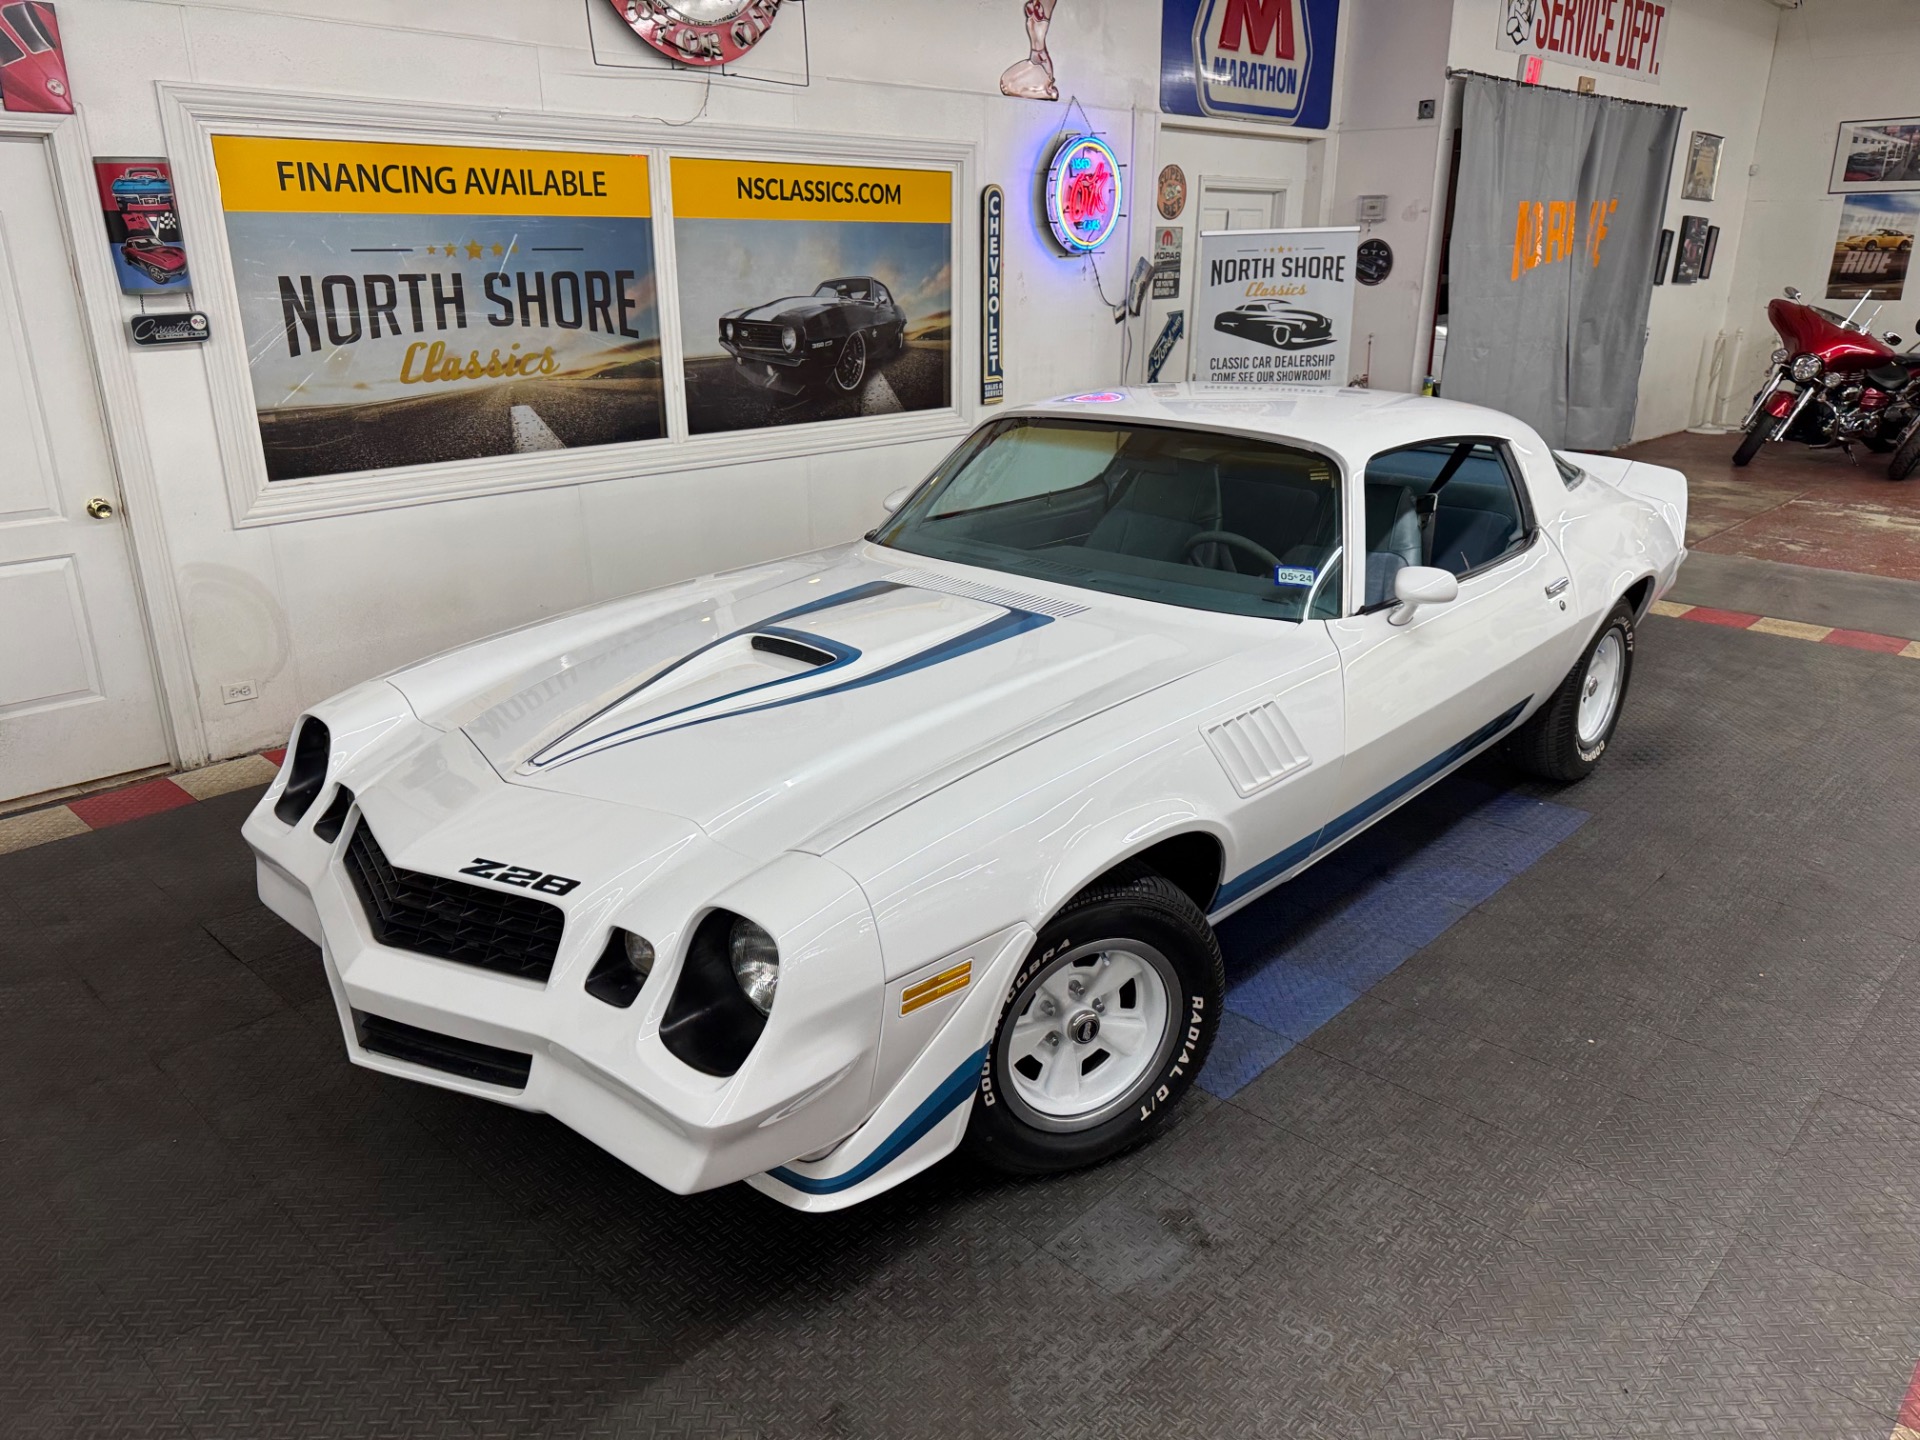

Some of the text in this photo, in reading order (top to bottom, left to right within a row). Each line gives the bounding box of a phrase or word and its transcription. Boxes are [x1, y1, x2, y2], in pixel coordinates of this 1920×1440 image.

[624, 0, 724, 62] OTOR
[1536, 0, 1665, 75] SERVICE DEPT.
[1212, 56, 1298, 95] MARATHON
[276, 161, 608, 197] FINANCING AVAILABLE
[737, 176, 902, 205] NSCLASSICS.COM
[1163, 197, 1182, 217] BEE
[1360, 248, 1388, 256] GTO
[1840, 251, 1892, 274] RIDE
[988, 196, 1000, 373] CHEVROLET
[1210, 255, 1346, 287] NORTH SHORE
[1245, 281, 1308, 297] Classics
[134, 318, 194, 340] Corvette
[277, 270, 640, 357] NORTH SHORE
[399, 340, 561, 385] Classics
[1210, 354, 1336, 370] CLASSIC CAR DEALERSHIP
[1211, 369, 1332, 382] COME SEE OUR SHOWROOM!
[458, 857, 582, 897] Z28
[1006, 938, 1071, 1004] COBRA
[1140, 995, 1204, 1121] RADIAL G/T
